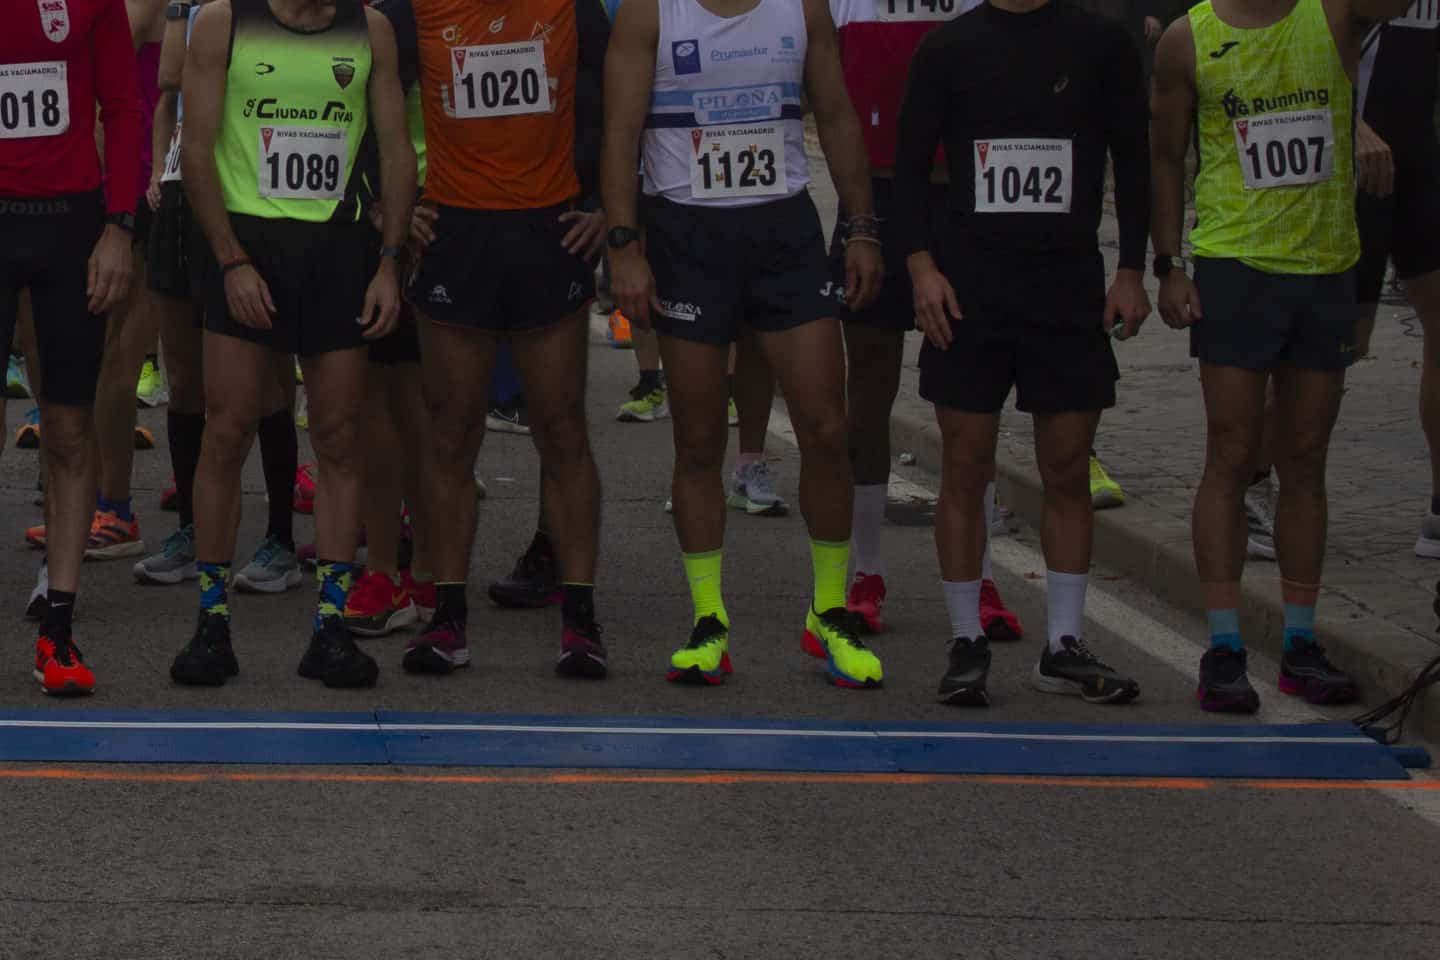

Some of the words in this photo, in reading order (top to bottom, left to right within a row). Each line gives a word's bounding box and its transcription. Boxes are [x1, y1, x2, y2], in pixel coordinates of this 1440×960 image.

[469, 49, 489, 58] RIVAS
[10, 67, 58, 76] VACIAMADRID
[461, 68, 539, 109] 1020
[1252, 88, 1329, 113] Running
[256, 98, 317, 120] CIUDAD
[705, 129, 726, 138] RIVAS
[991, 144, 1012, 152] RIVAS
[1014, 144, 1063, 152] VACIAMADRID
[1245, 136, 1325, 179] 1007
[266, 152, 339, 191] 1089
[697, 149, 777, 189] 1123
[983, 166, 1063, 203] 1042
